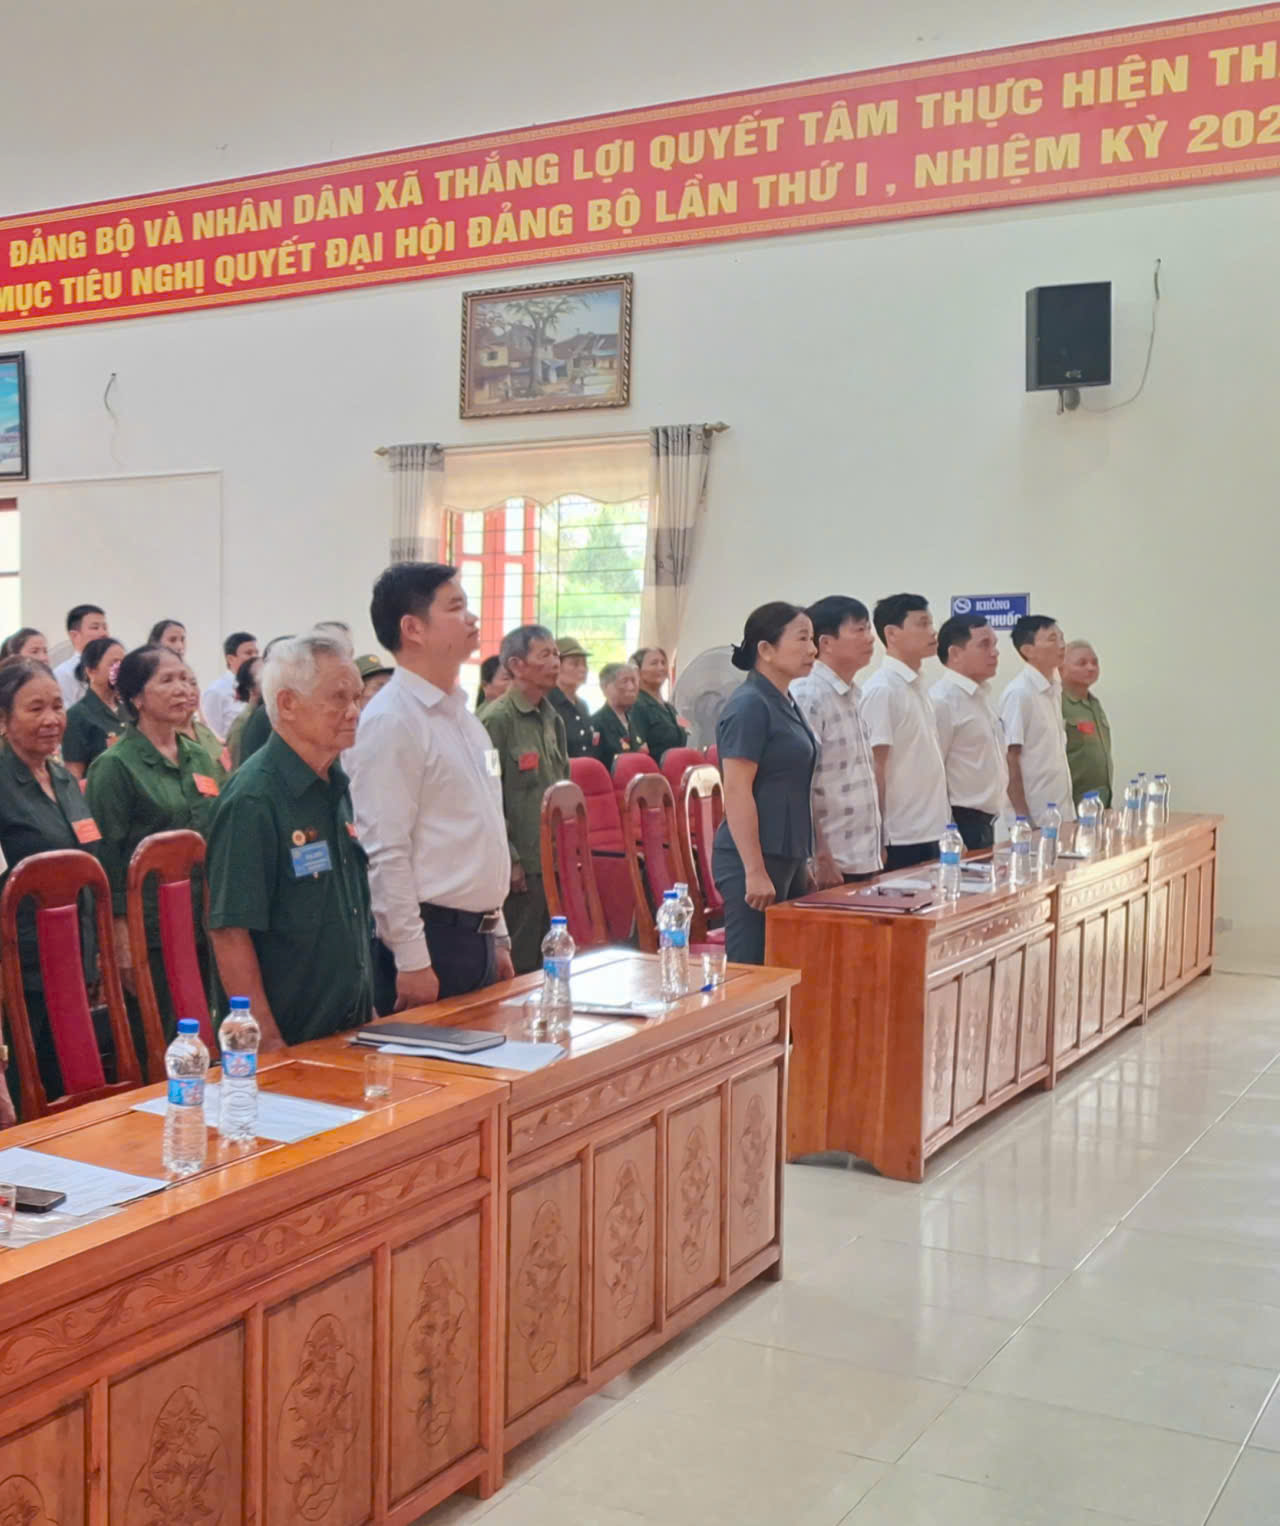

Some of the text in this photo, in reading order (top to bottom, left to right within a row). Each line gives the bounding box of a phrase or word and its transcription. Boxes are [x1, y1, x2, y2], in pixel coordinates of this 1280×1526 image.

[10, 40, 1280, 268] ĐẢNG BỘ VÀ NHÂN DÂN XÃ THẮNG LỢI QUYẾT TÂM THỰC HIỆN TH
[60, 261, 121, 305] TIÊU
[131, 259, 204, 296] NGHỊ
[215, 234, 316, 287] QUYẾT
[325, 231, 383, 271] ĐẠI
[395, 218, 455, 262] HỘI
[468, 202, 573, 249] ĐẢNG
[588, 188, 640, 234] BỘ
[655, 174, 738, 224] LẦN
[753, 160, 844, 209] THỨ
[914, 132, 1080, 189] NHIỆM
[1100, 114, 1168, 164] KỲ
[1187, 104, 1280, 154] 202
